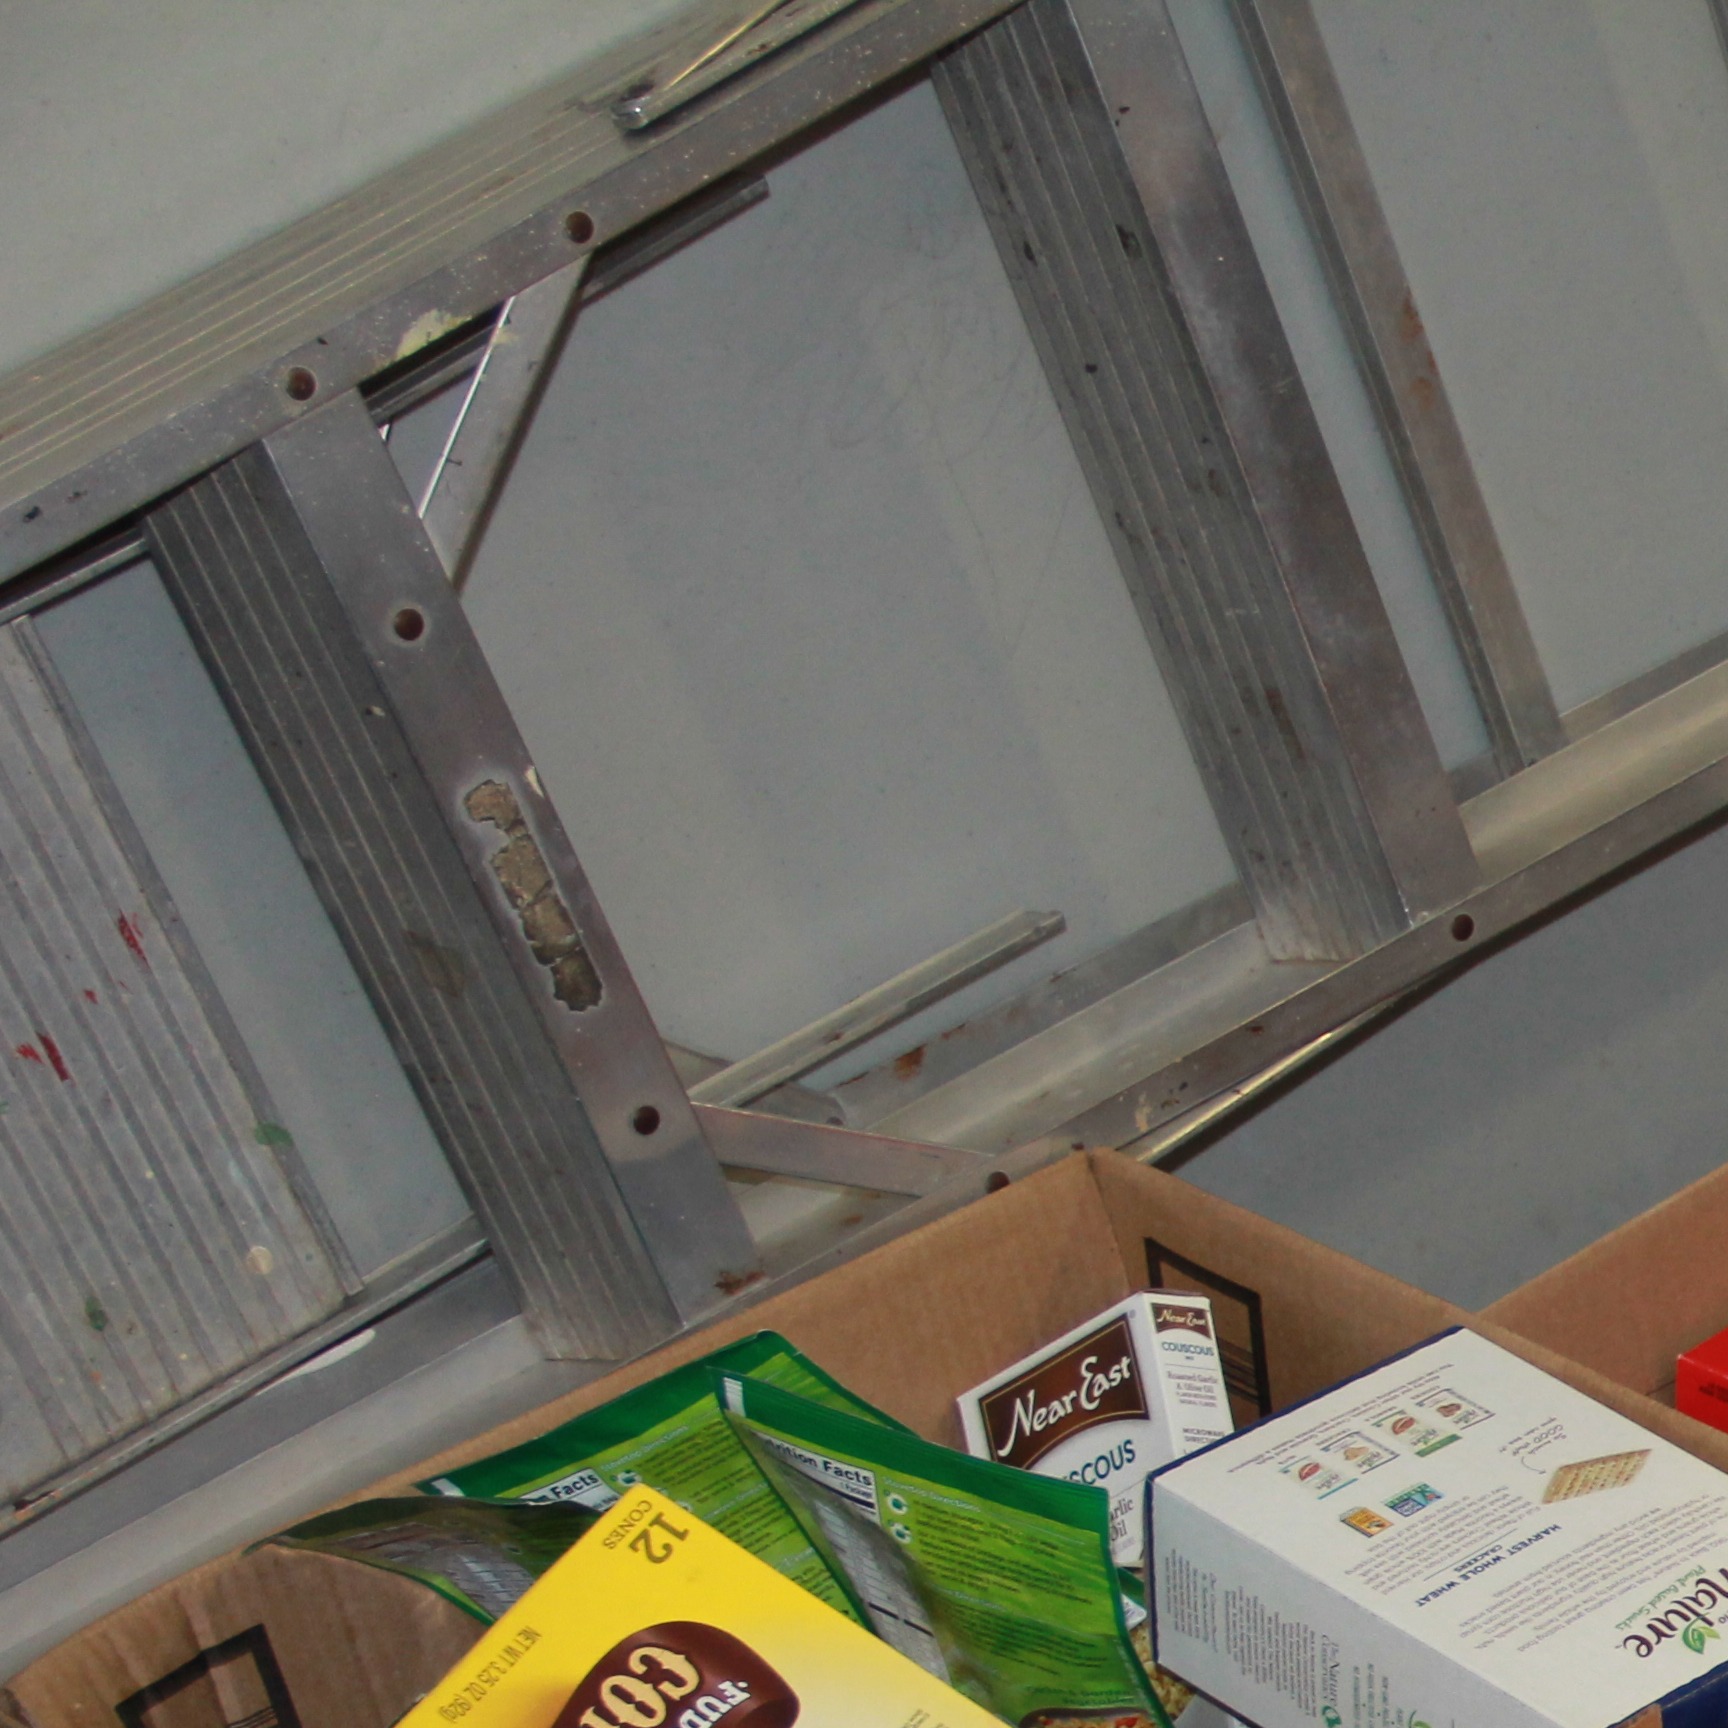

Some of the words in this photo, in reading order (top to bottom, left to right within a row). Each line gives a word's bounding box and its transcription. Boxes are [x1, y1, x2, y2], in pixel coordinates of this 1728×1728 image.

[1160, 1340, 1216, 1357] COUSCOUS
[997, 1388, 1078, 1458] Near
[1079, 1354, 1132, 1412] East
[602, 1498, 654, 1551] CONES
[628, 1511, 691, 1565] 12
[1506, 1523, 1562, 1556] HARVEST
[1453, 1544, 1503, 1574] CRACKERS
[1459, 1554, 1503, 1582] WHOLE
[1415, 1579, 1460, 1609] WHEAT
